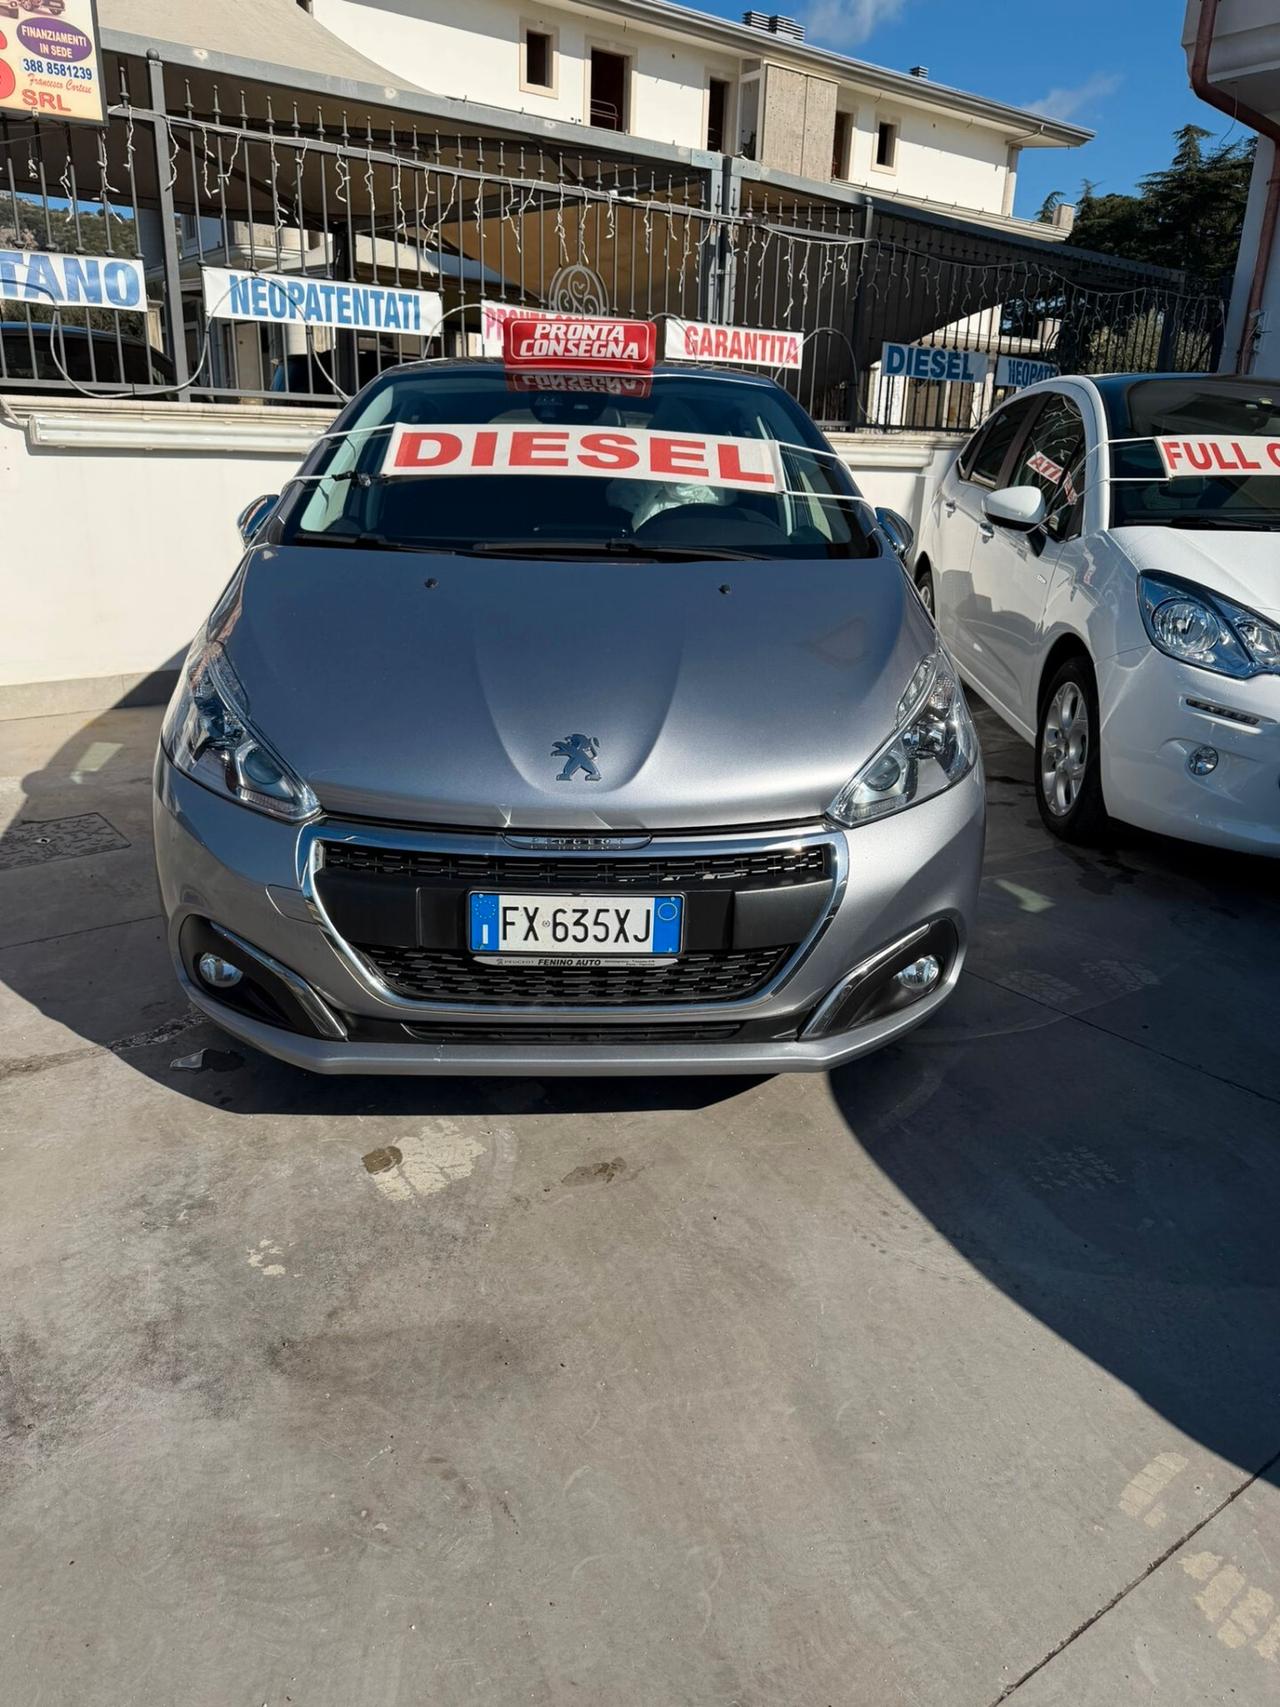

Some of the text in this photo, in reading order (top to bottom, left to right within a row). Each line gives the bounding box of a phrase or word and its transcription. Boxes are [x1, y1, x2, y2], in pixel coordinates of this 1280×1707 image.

[21, 25, 87, 47] FINANZIAMENTI
[39, 43, 73, 58] IN SEDE
[23, 58, 92, 80] 388 8581239
[22, 88, 71, 112] SRL
[229, 274, 421, 330] NEOPATENTATI
[534, 323, 625, 341] PRONTA
[520, 340, 639, 359] CONSEGNA
[684, 325, 799, 364] GARANTITA
[886, 345, 974, 381] DIESEL
[394, 431, 775, 484] DIESEL
[1161, 442, 1262, 470] FULL
[502, 906, 651, 943] FX 635XJ
[538, 958, 574, 966] FENINO
[576, 958, 601, 967] AUTO
